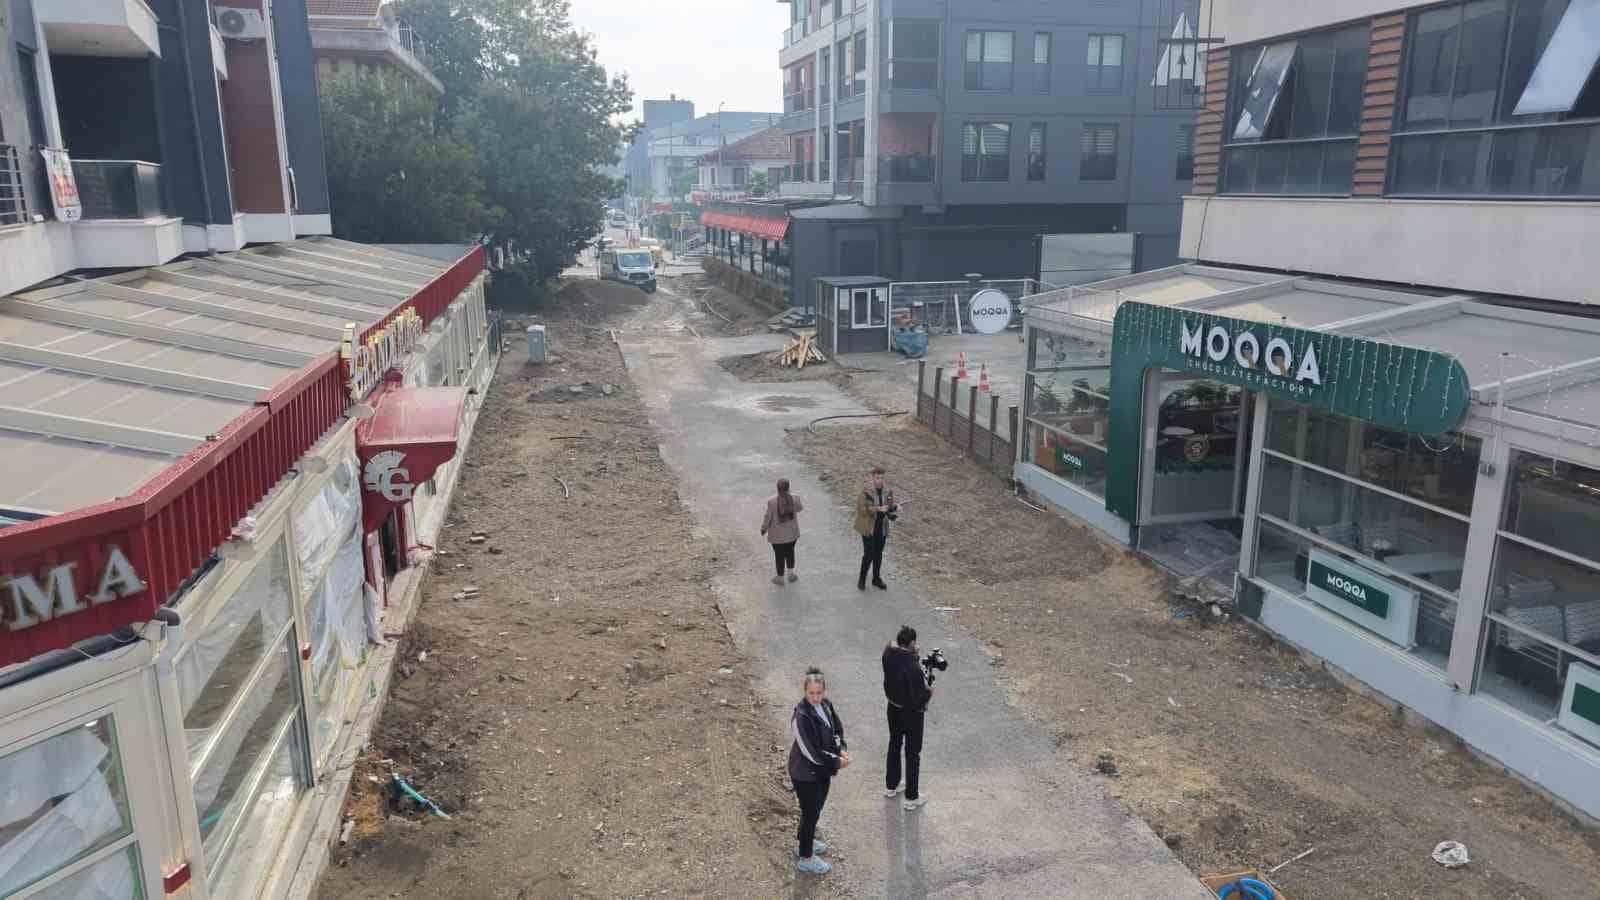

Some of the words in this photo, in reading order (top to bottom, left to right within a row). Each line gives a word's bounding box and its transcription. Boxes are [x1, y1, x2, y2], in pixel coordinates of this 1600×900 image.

[972, 307, 1008, 317] MOQQA
[1181, 317, 1321, 385] MOQQA
[0, 543, 148, 632] MA
[1327, 572, 1367, 601] MOQQA
